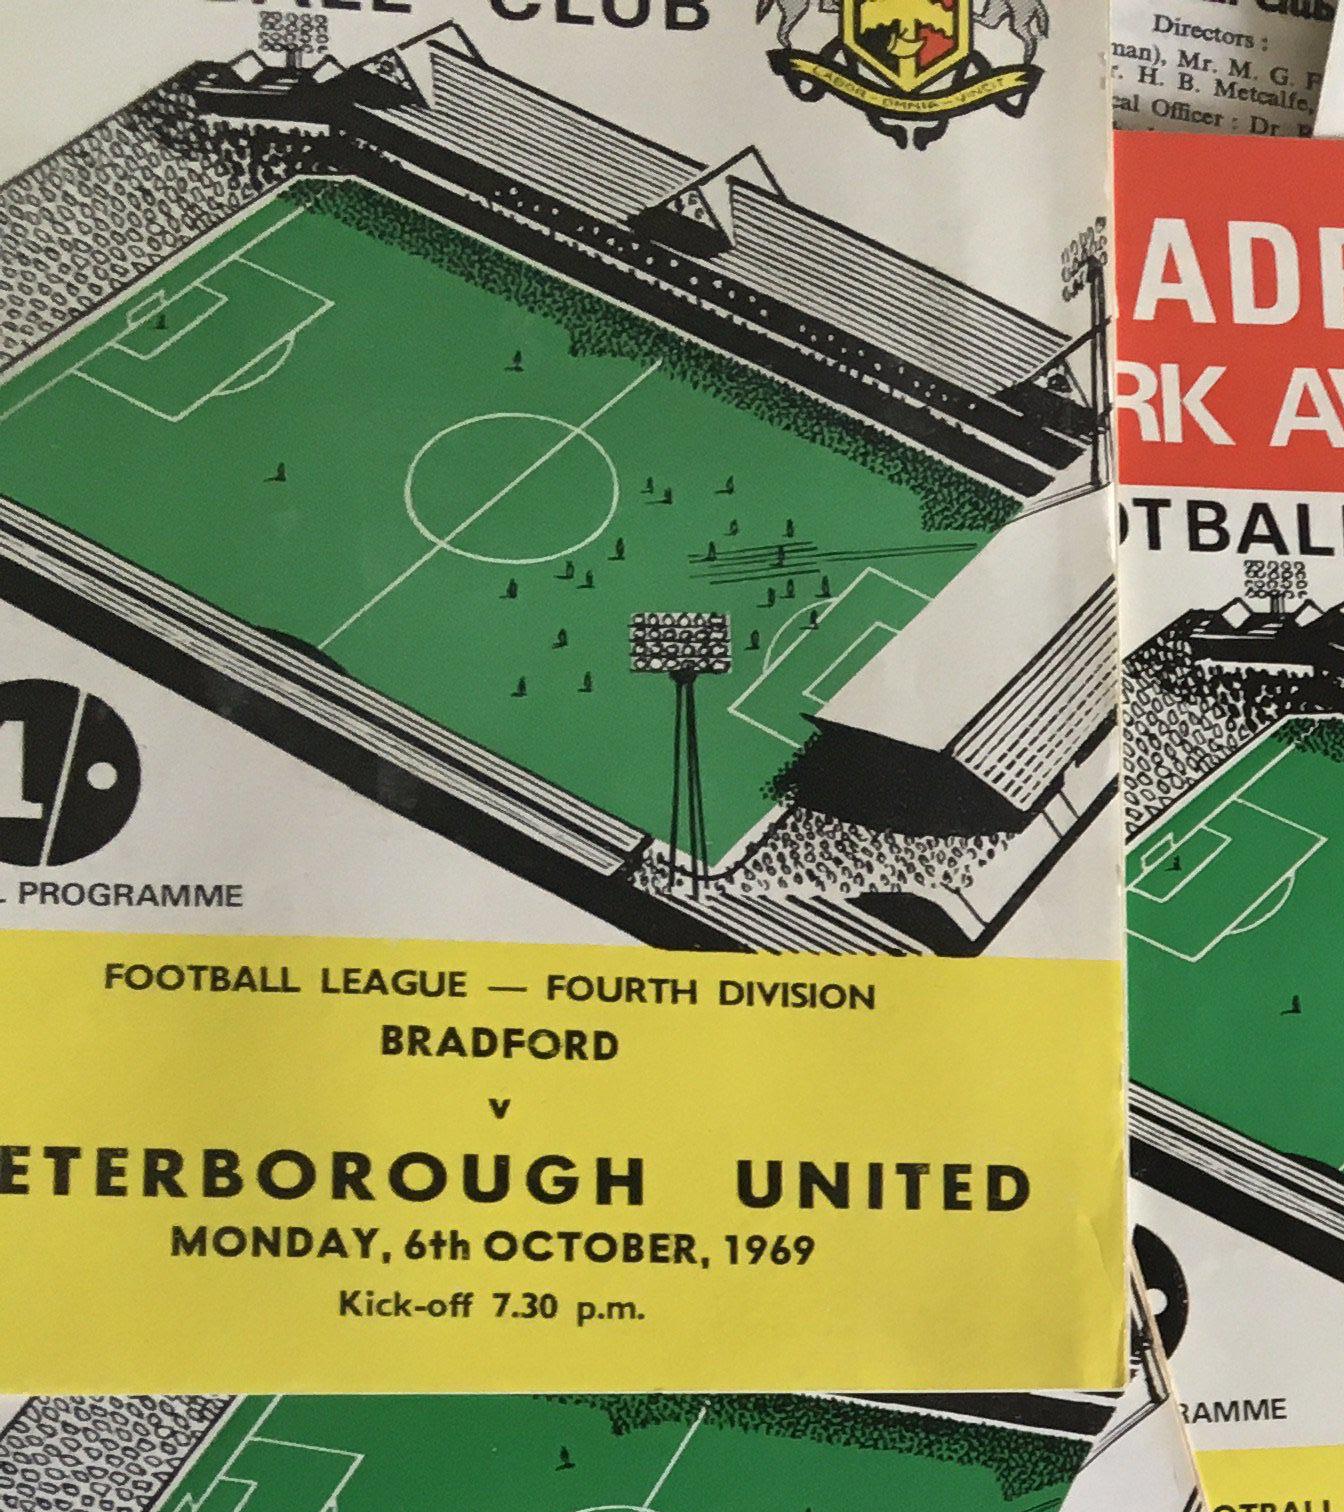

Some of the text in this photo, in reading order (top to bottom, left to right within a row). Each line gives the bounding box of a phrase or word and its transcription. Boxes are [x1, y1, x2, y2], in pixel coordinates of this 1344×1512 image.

[1153, 13, 1255, 50] Directors
[1177, 49, 1295, 87] Mr. M. G.
[1138, 66, 1315, 115] H. B. Metcalfe,
[1151, 99, 1224, 127] Officer
[18, 881, 243, 908] PROGRAMME
[104, 963, 876, 1010] FOOTBALL LEAGUE FOURTH DIVISION
[380, 1024, 619, 1061] BRADFORD
[488, 1098, 511, 1120] v
[736, 1159, 1031, 1212] UNITED
[170, 1224, 816, 1270] MONDAY, 6th OCTOBER, 1969
[338, 1289, 646, 1327] Kick-off 7.30 p.m.
